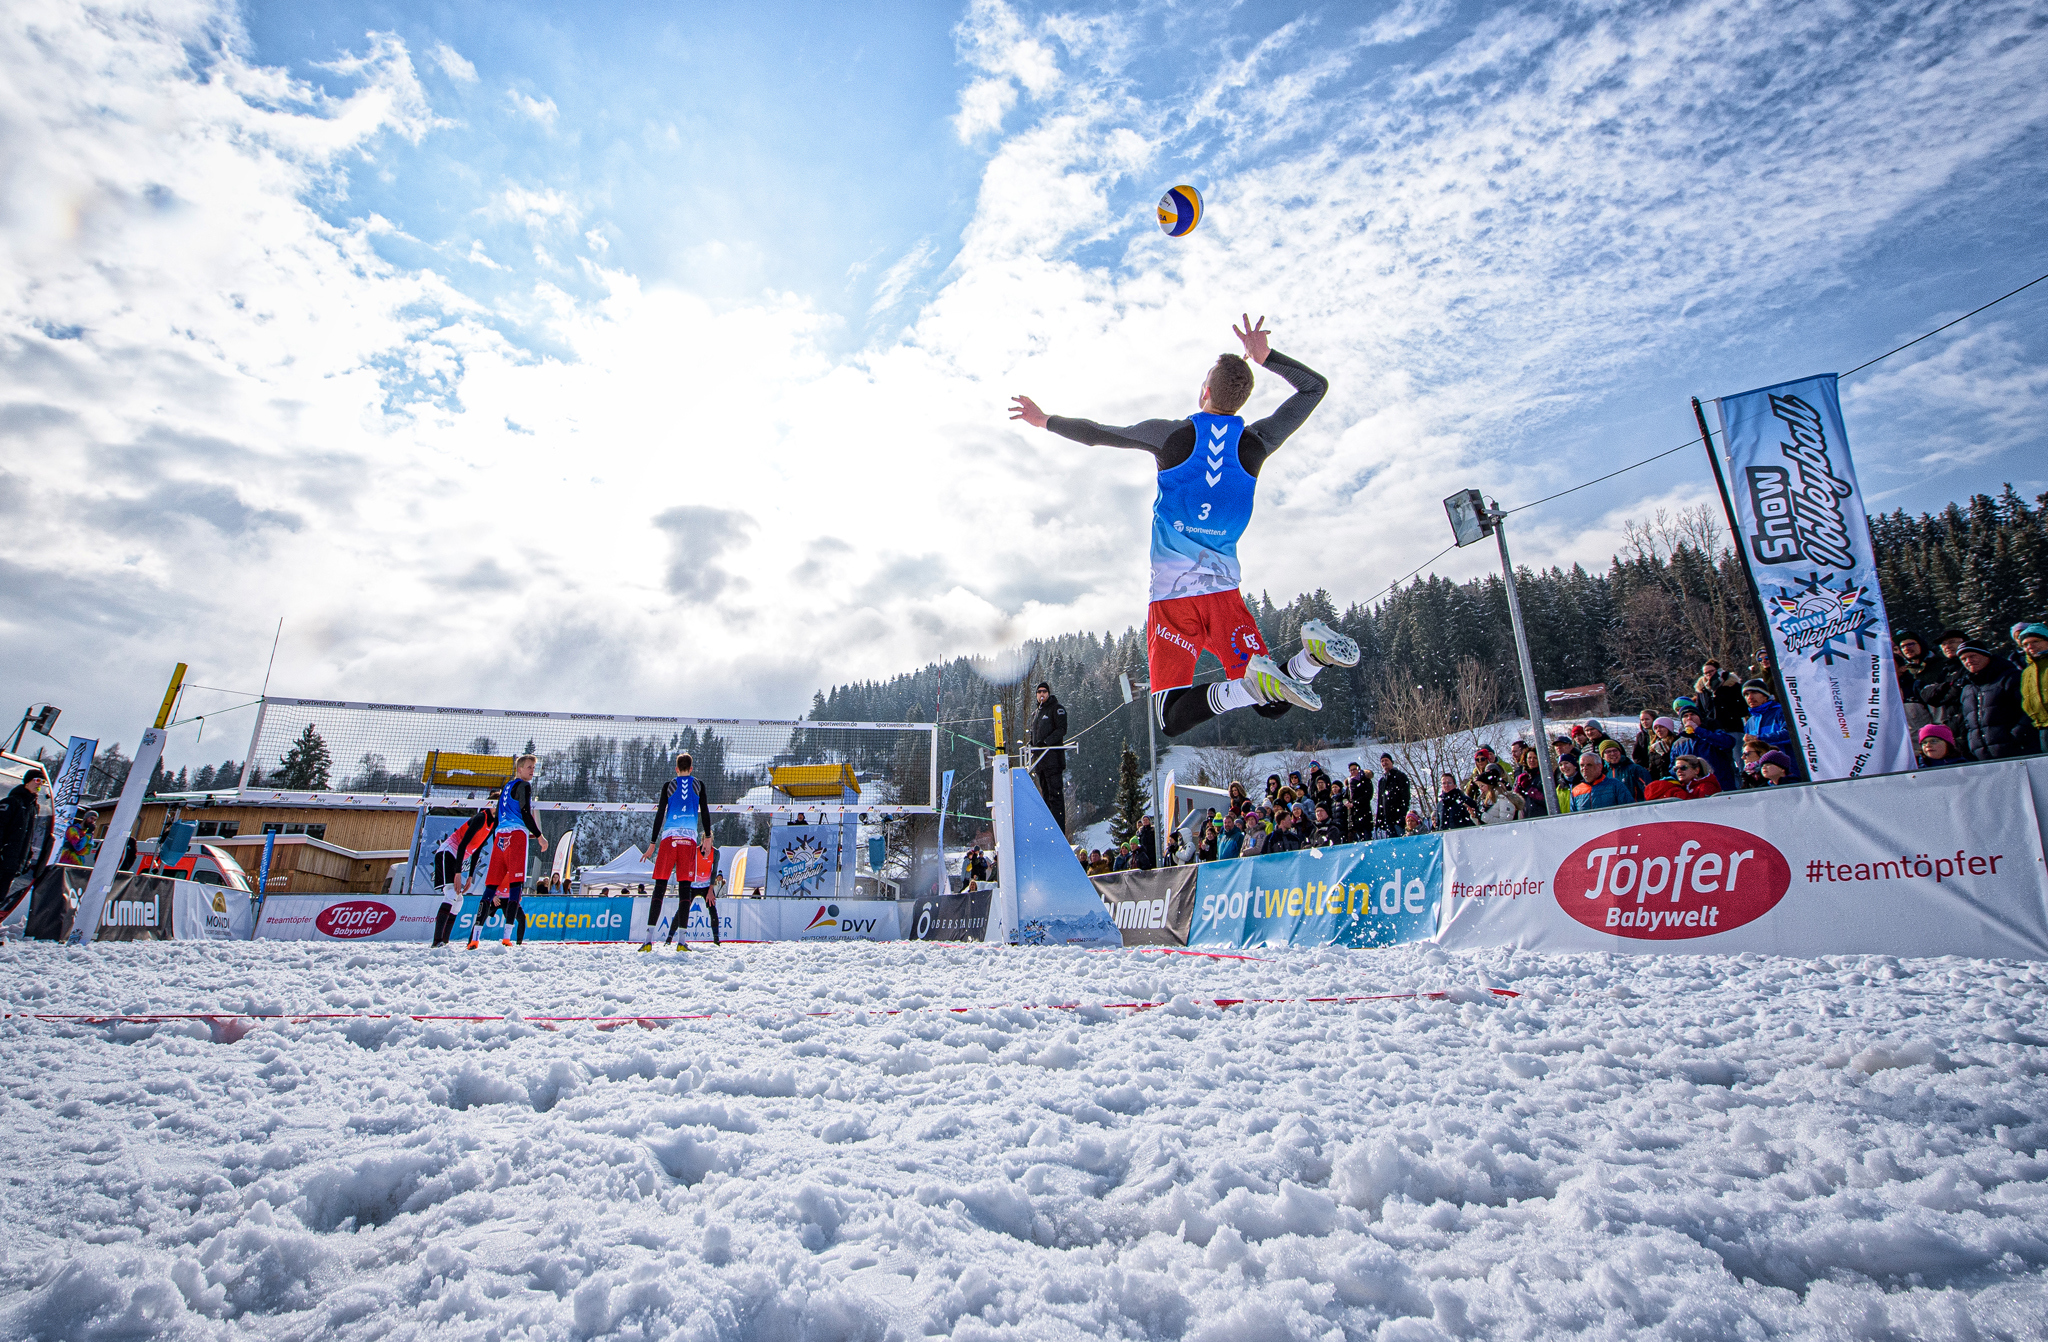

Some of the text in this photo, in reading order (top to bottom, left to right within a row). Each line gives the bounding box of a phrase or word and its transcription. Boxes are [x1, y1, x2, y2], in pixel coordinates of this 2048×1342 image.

[1772, 395, 1854, 568] Volleyball
[1198, 503, 1212, 520] 3
[1752, 469, 1801, 562] Snow
[1781, 613, 1824, 636] Snow
[1787, 609, 1865, 652] Volleyball
[1871, 654, 1880, 683] snow
[297, 699, 346, 707] sportwetten.de
[1868, 687, 1880, 704] the
[368, 703, 415, 711] sportwetten.de
[437, 707, 483, 715] sportwetten.de
[504, 710, 549, 718] sportwetten.de
[1866, 708, 1879, 718] in
[570, 713, 615, 721] sportwetten.de
[697, 717, 739, 725] sportwetten.de
[1863, 721, 1879, 749] even
[1584, 840, 1754, 903] Töpfer
[1805, 850, 2003, 882] #teamtöpfer
[1451, 877, 1545, 899] #teamtöpfer
[1201, 869, 1426, 929] sportwetten.de
[206, 915, 230, 929] MONDI
[266, 916, 313, 925] #teamtöpfer
[328, 907, 389, 927] Töpfer
[841, 919, 876, 932] DVV
[1605, 906, 1719, 932] Babywelt
[333, 927, 372, 936] Babywelt
